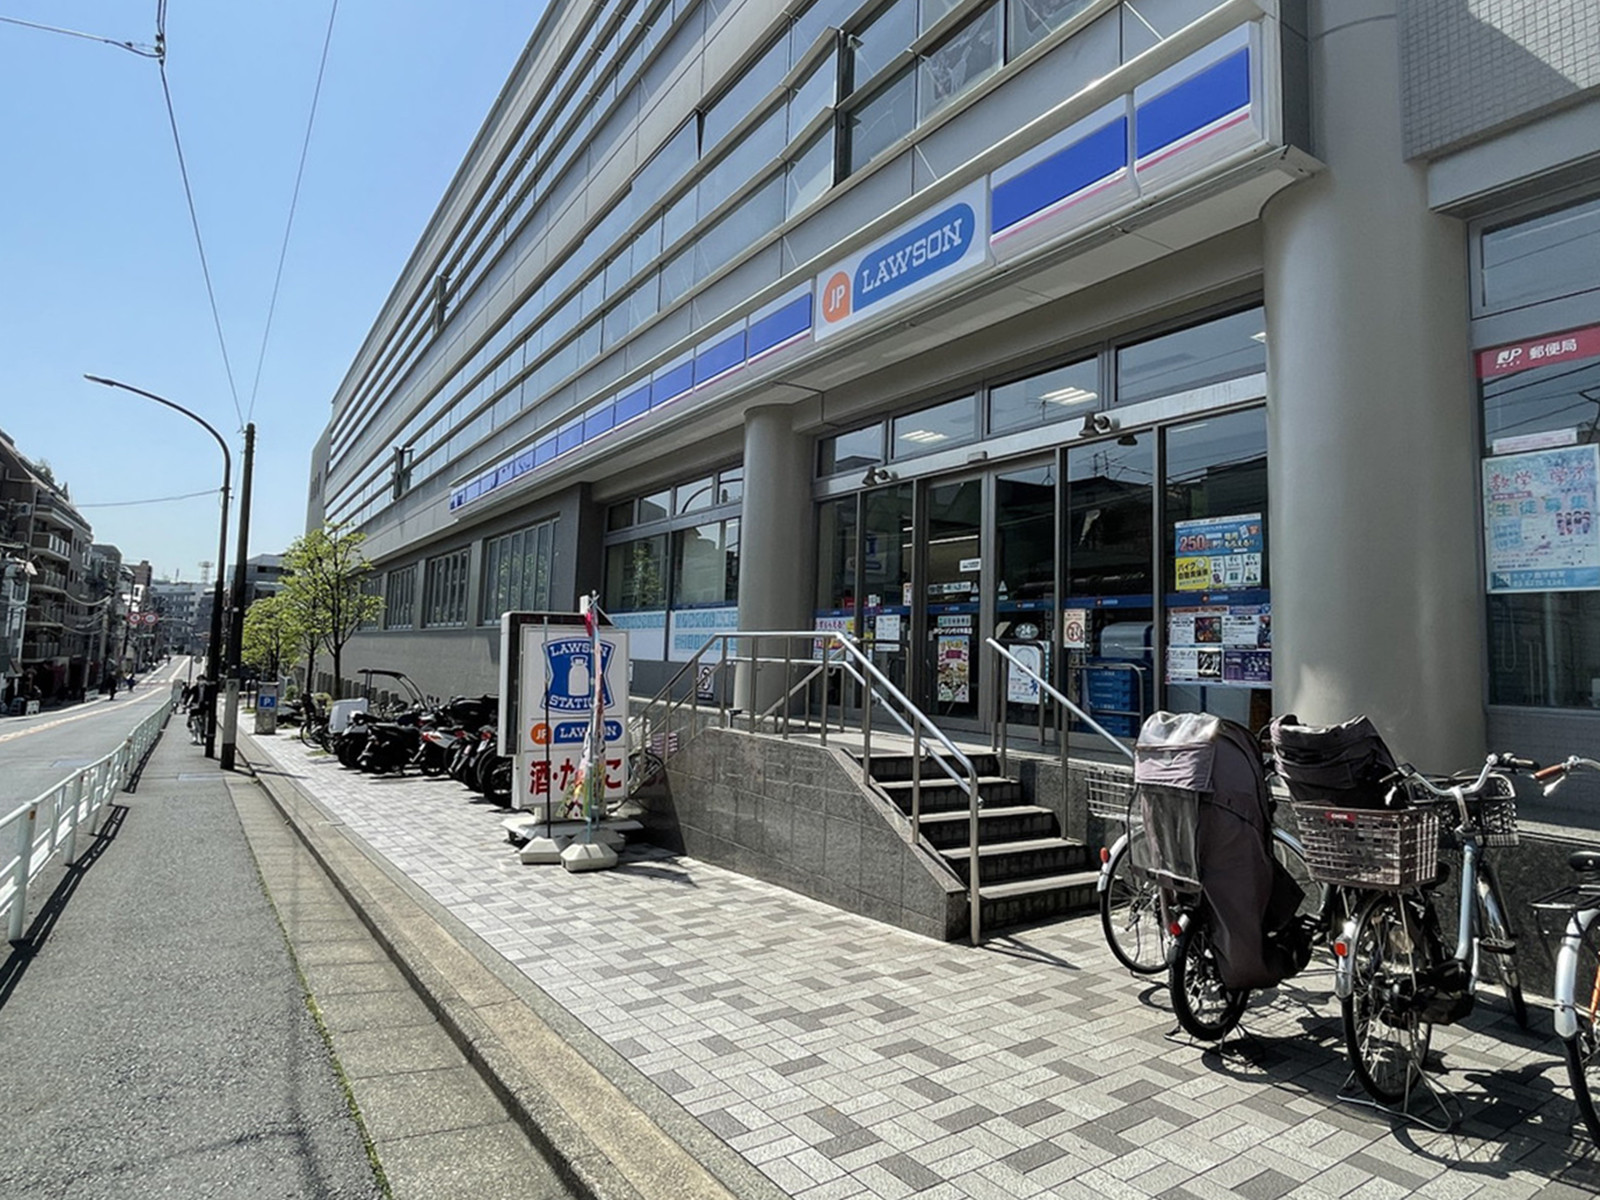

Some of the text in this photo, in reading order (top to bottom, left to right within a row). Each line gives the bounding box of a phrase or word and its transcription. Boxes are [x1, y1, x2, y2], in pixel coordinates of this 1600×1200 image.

[829, 218, 962, 313] JP LAWSON
[1529, 338, 1577, 360] 郵便局
[549, 643, 609, 657] LAWSN
[560, 725, 617, 739] LAWN
